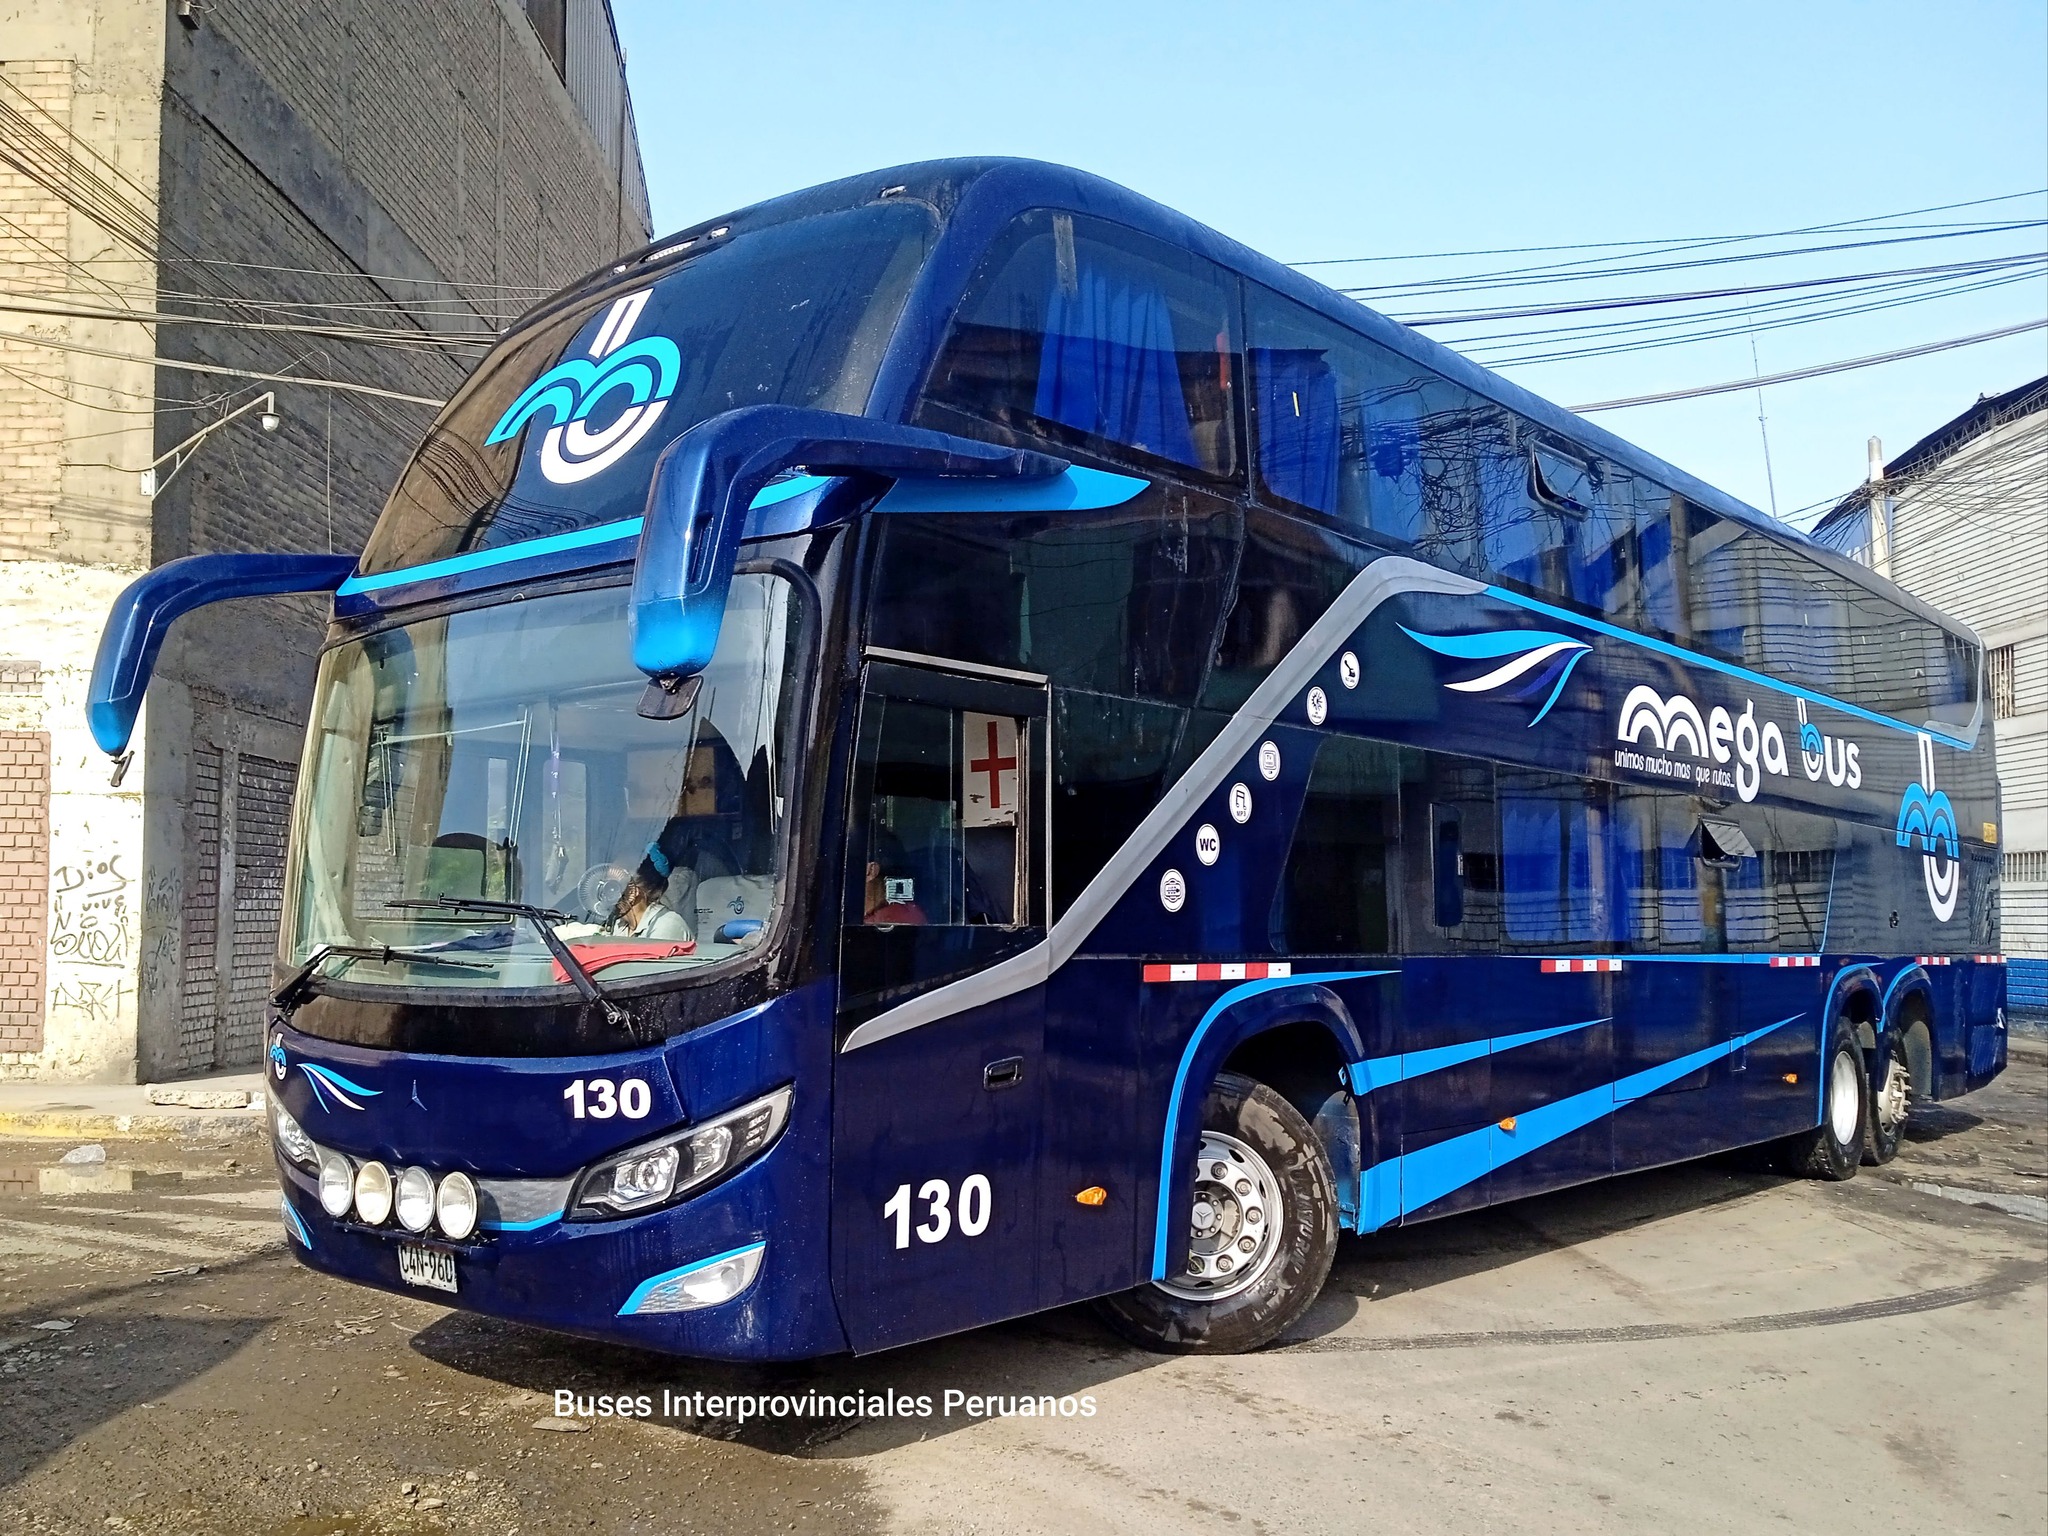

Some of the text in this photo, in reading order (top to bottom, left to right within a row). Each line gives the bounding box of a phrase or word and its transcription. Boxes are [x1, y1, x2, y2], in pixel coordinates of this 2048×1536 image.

[1618, 685, 1862, 802] mega bus
[1614, 748, 1644, 771] unimos
[1645, 754, 1672, 777] mucho
[1674, 761, 1691, 780] mas
[1695, 765, 1710, 787] que
[1199, 838, 1217, 852] WC
[563, 1078, 652, 1120] 130
[884, 1173, 992, 1250] 130
[400, 1246, 453, 1283] C4N-960
